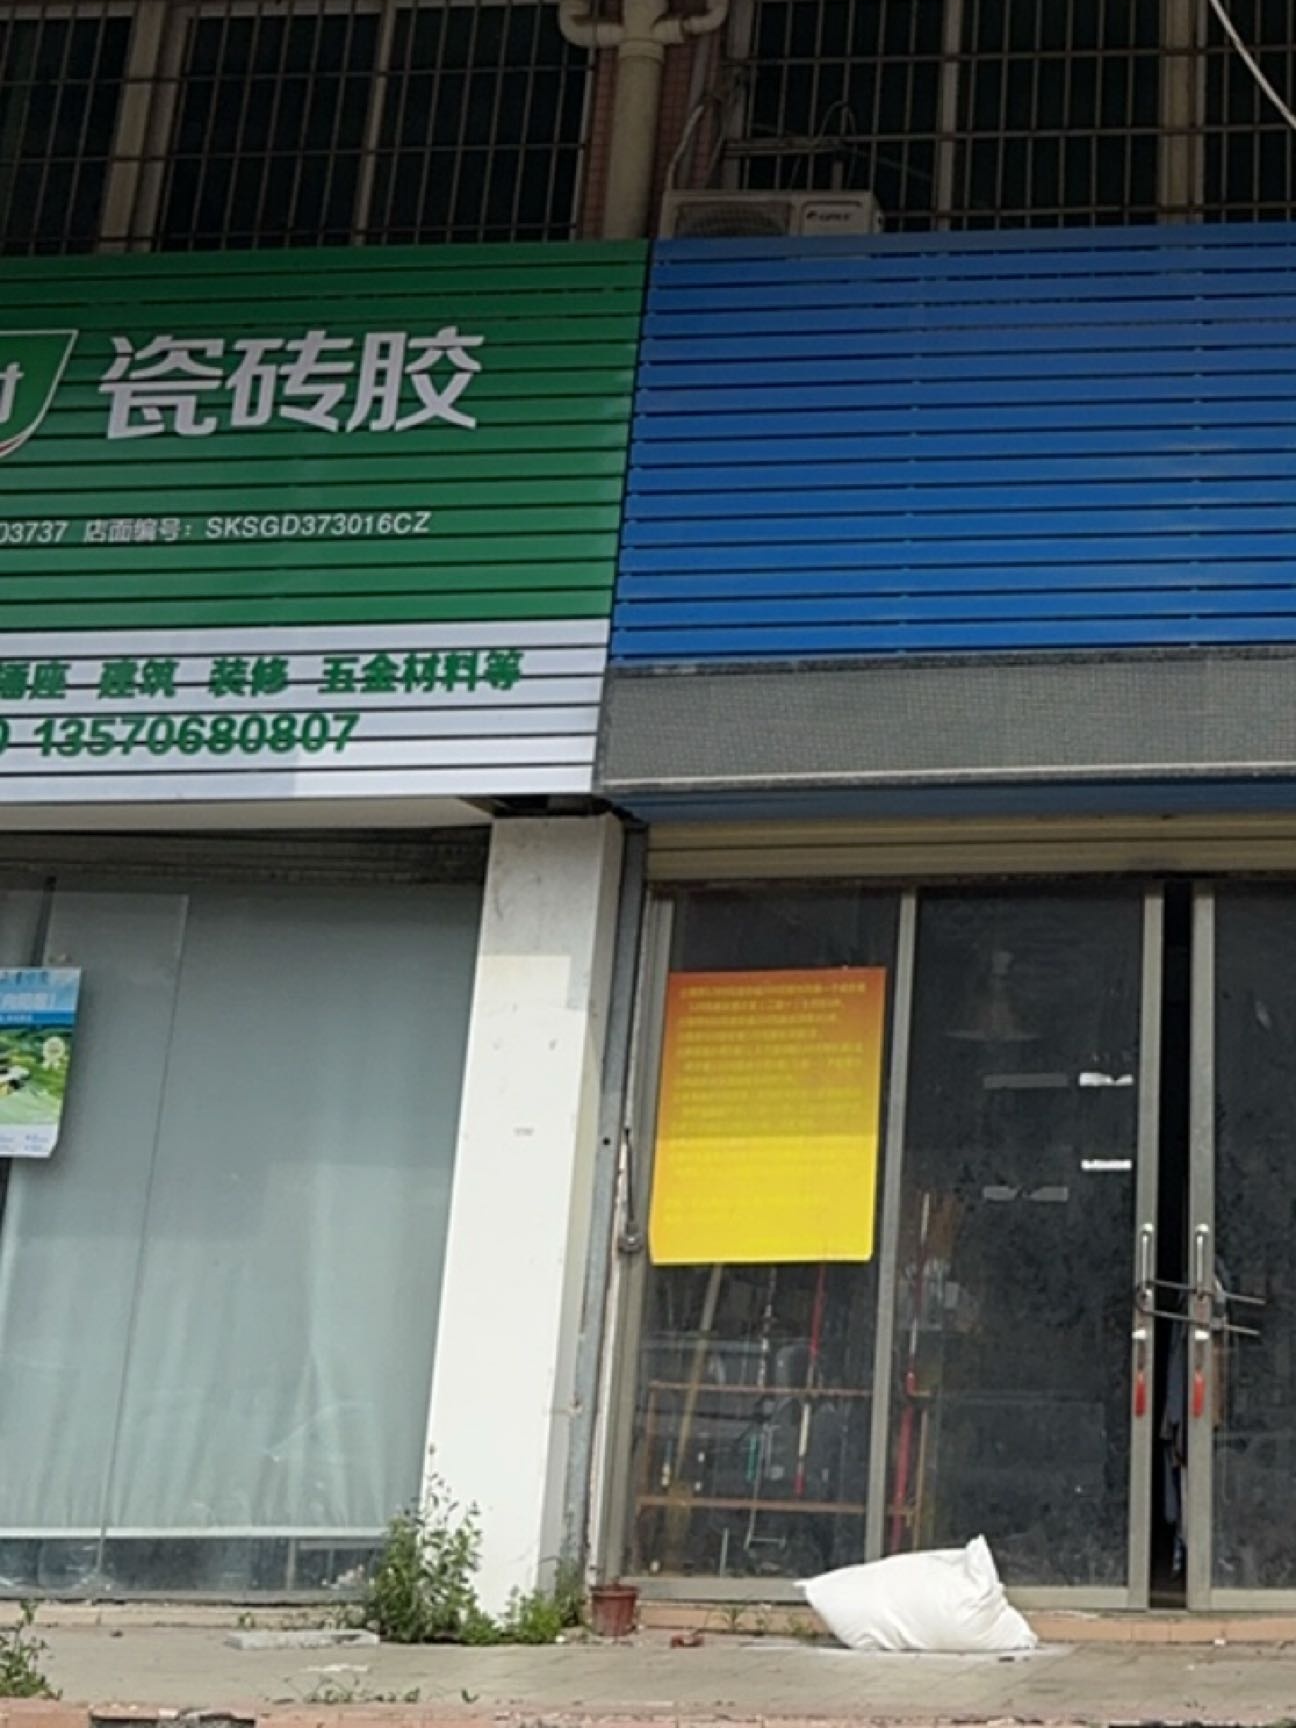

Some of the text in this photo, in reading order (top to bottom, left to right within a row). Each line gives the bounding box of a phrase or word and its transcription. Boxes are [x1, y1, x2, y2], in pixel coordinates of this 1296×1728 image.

[98, 325, 485, 440] 瓷砖胶
[97, 657, 180, 700] 建筑
[208, 655, 289, 698] 装修
[317, 649, 524, 694] 五金材料等
[33, 712, 361, 757] 13570680807
